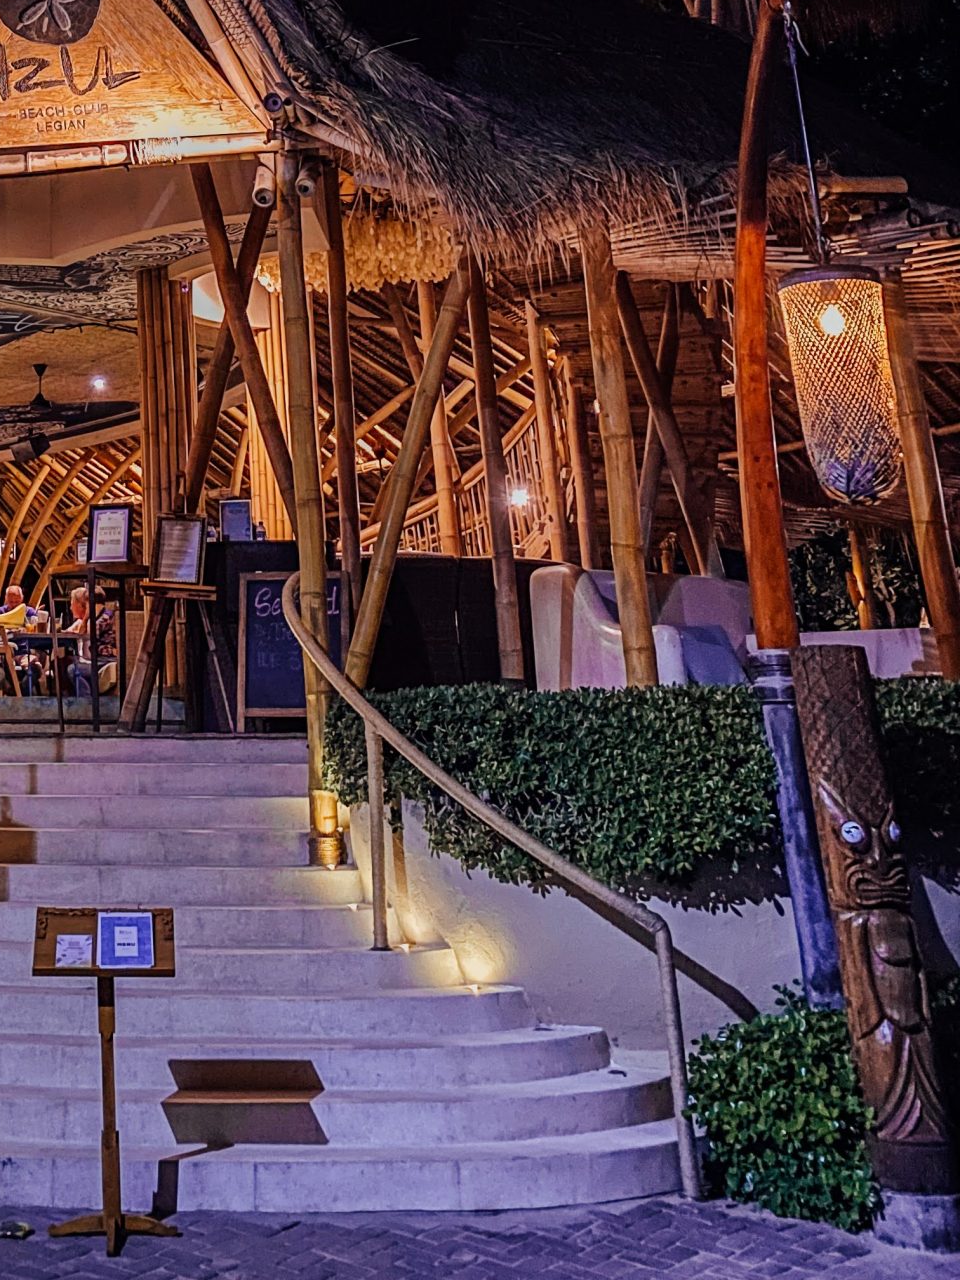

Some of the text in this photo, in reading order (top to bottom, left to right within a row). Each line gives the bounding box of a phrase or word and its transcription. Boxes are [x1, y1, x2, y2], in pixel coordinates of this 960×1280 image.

[19, 103, 109, 119] BEACH CLUB
[36, 119, 87, 133] LEGIAN
